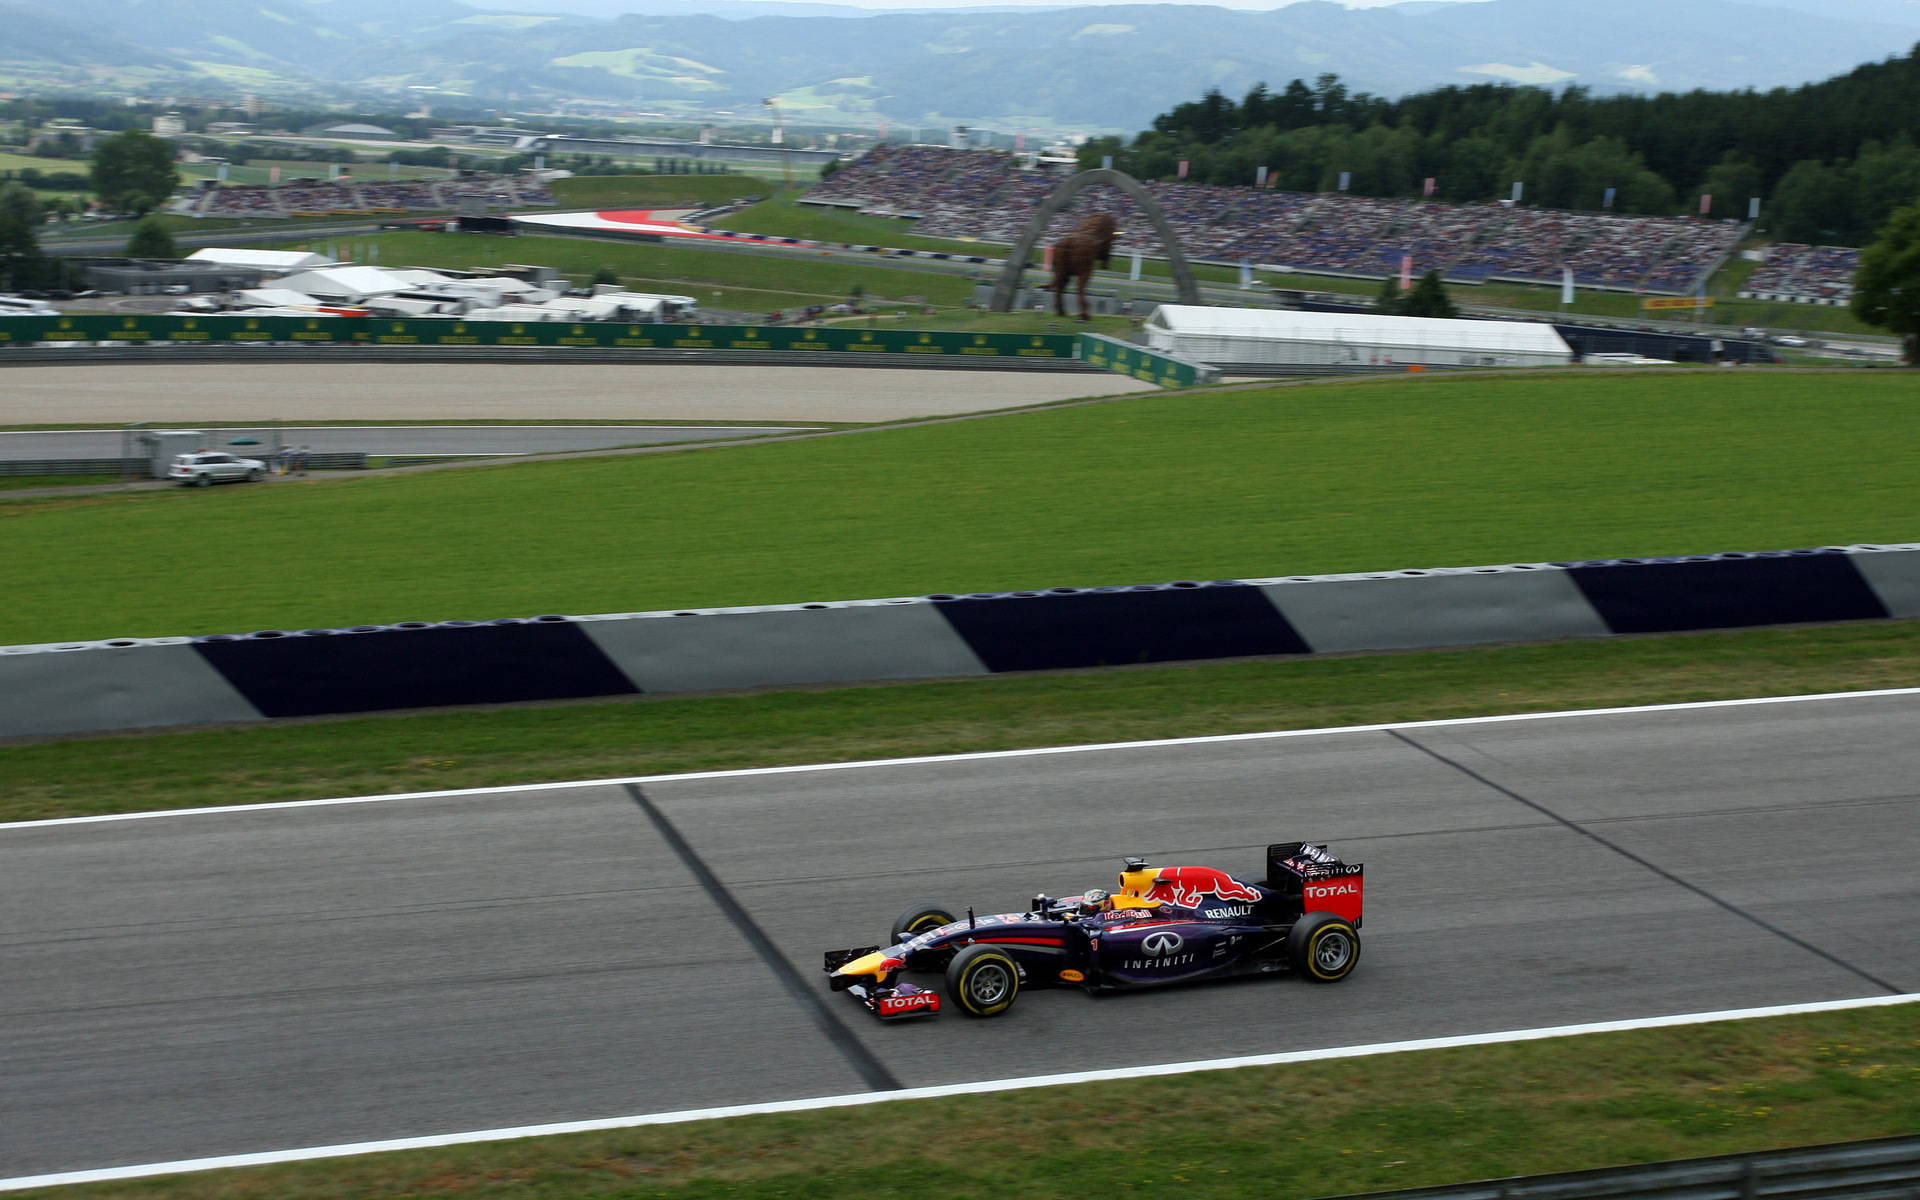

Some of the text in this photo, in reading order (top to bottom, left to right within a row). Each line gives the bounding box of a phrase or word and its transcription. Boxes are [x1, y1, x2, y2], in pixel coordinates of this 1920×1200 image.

[1305, 884, 1357, 898] TOTAL
[1204, 904, 1254, 918] RENAULT
[1091, 939, 1098, 951] 1
[1124, 953, 1194, 969] INFINITI
[884, 995, 936, 1008] TOTAL
